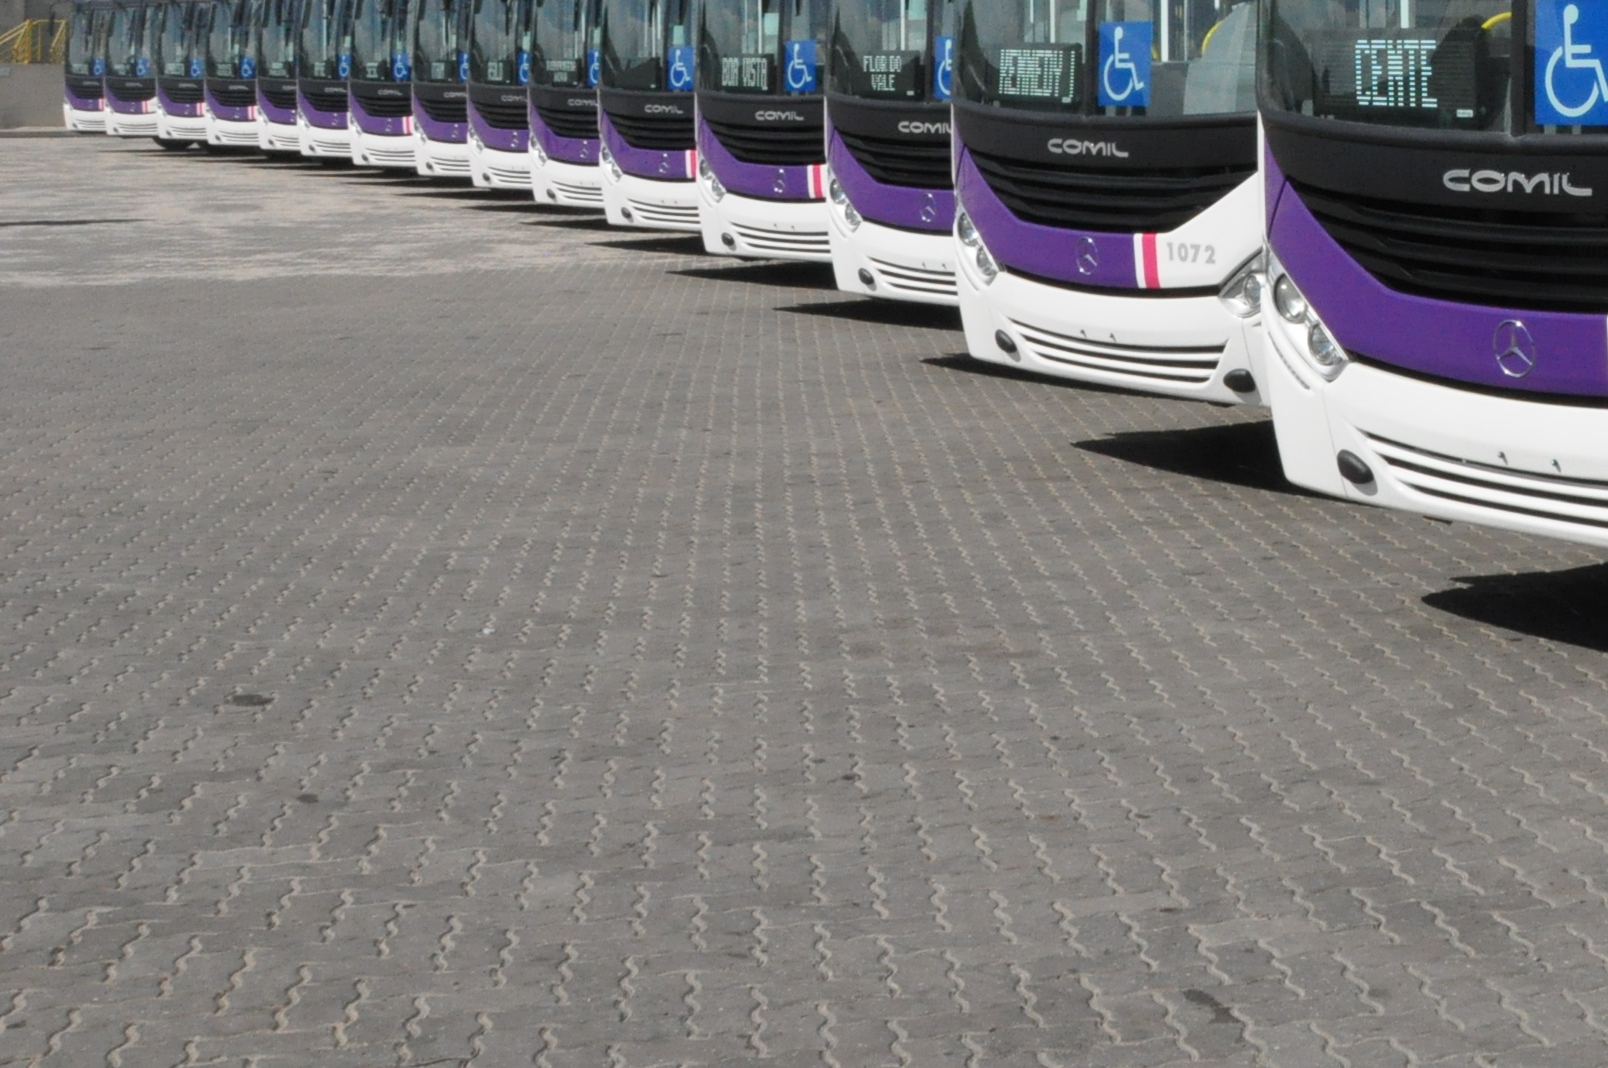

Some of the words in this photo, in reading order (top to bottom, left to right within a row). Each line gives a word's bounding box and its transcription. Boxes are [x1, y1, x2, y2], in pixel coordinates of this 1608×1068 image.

[755, 110, 804, 121] COMIL
[1047, 138, 1129, 158] COMIL
[1443, 168, 1592, 198] COMIL
[1166, 241, 1216, 265] 1072
